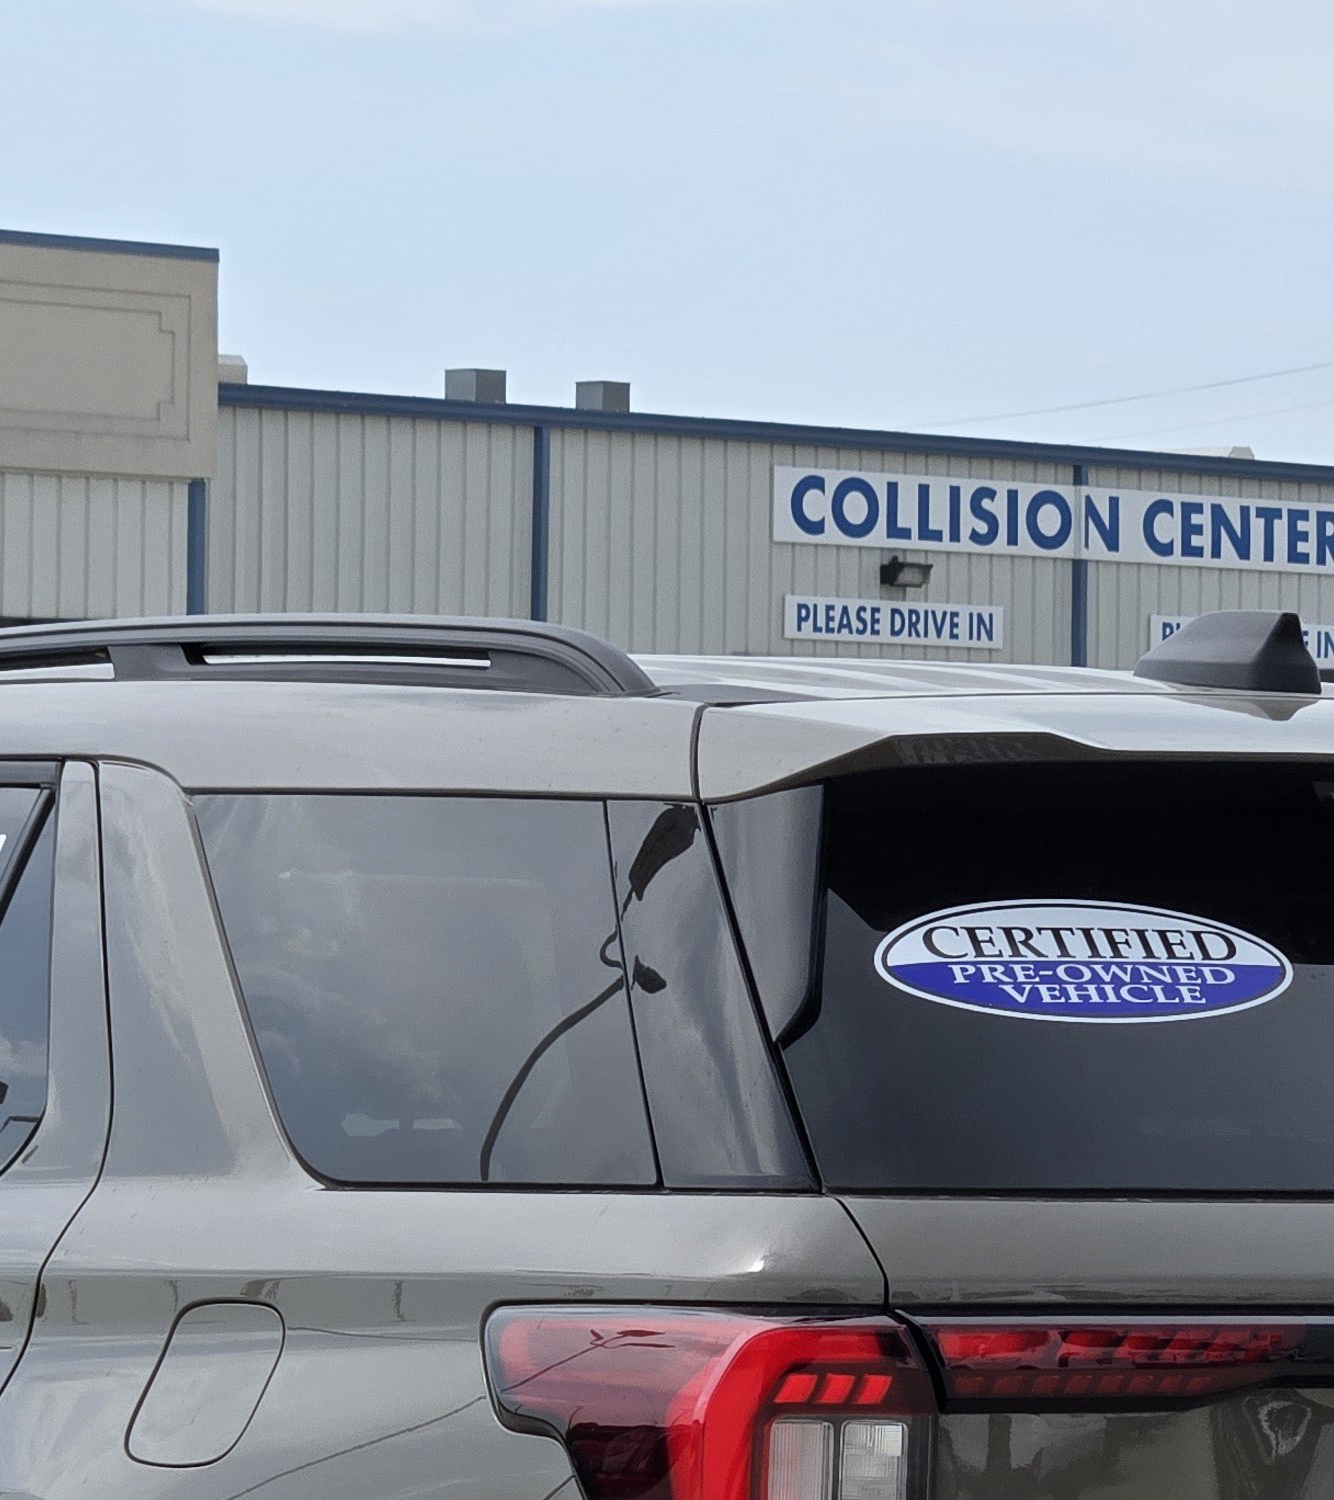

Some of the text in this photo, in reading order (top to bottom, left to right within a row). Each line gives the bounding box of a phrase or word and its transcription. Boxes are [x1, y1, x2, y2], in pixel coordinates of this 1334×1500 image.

[790, 474, 1120, 552] COLLISION
[796, 602, 994, 641] PLEASE DRIVE IN
[921, 925, 1238, 961] CERTIFIED
[947, 963, 1235, 985] PRE-OWNED
[997, 984, 1207, 1004] VEHICLE
